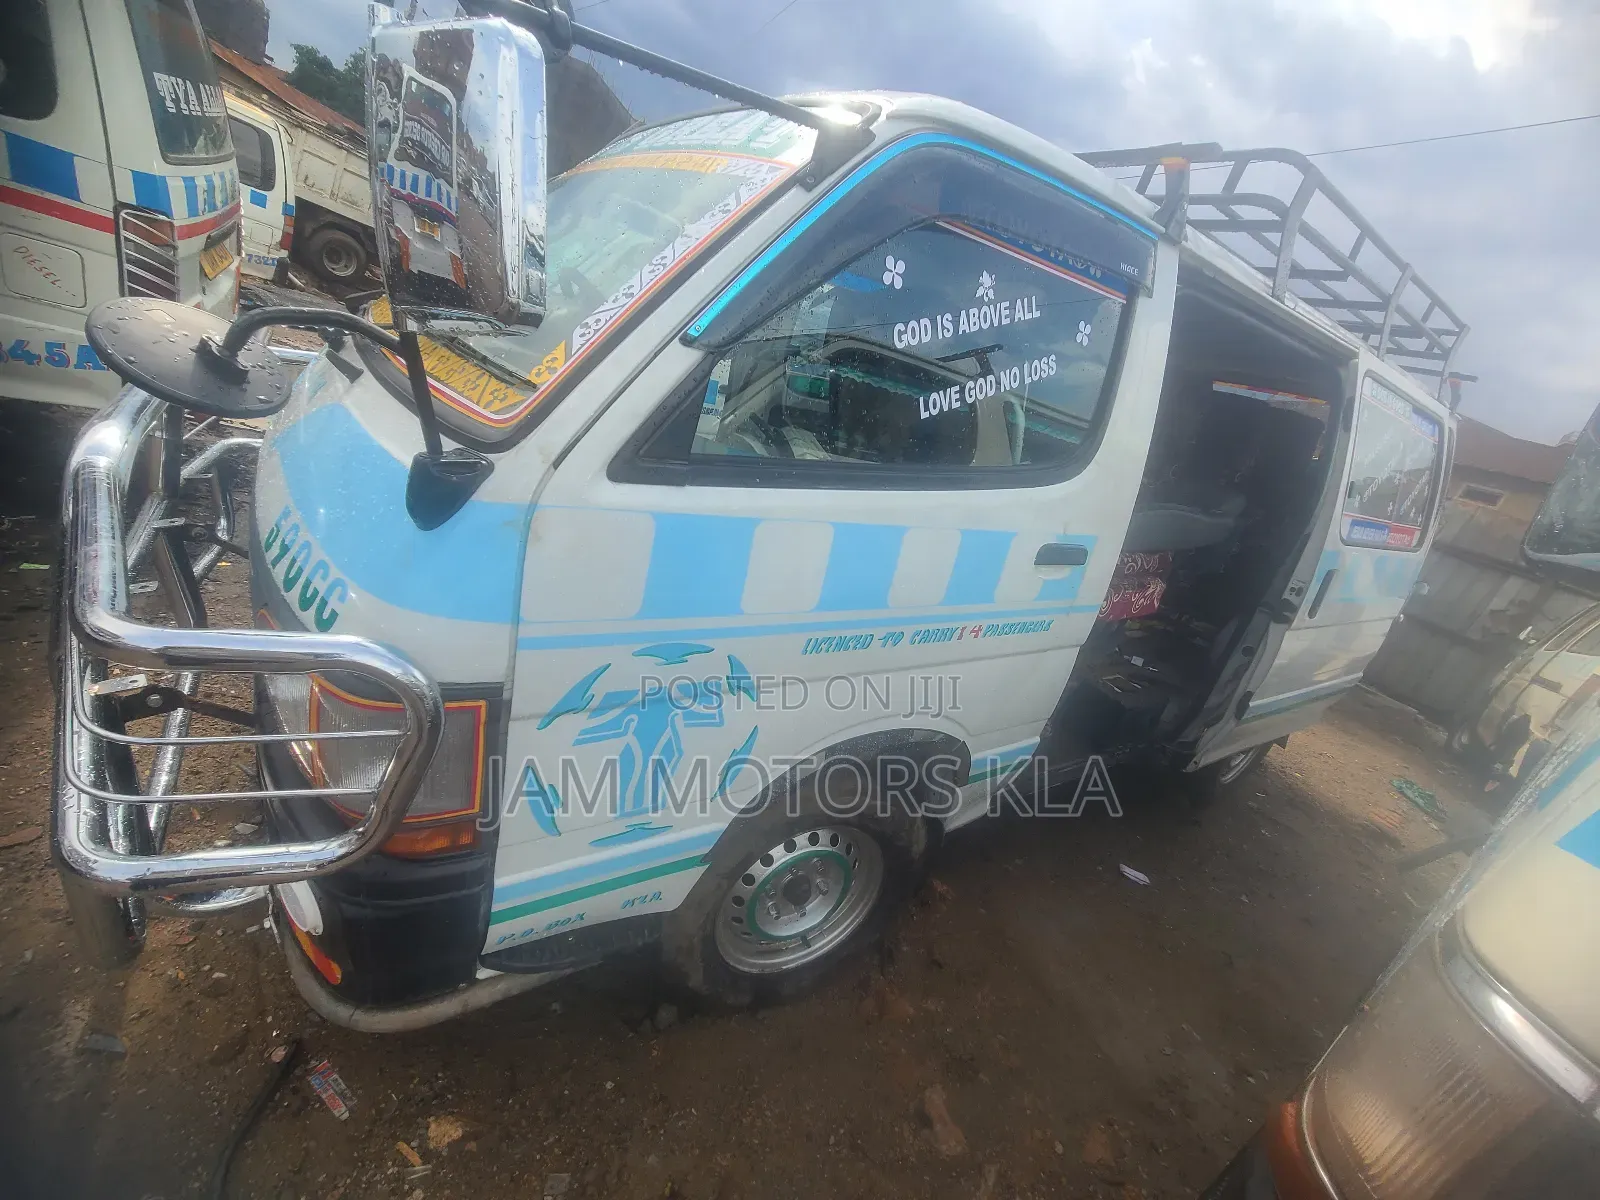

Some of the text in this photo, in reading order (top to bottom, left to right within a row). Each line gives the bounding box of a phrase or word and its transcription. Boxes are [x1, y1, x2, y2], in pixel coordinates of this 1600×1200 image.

[12, 246, 62, 288] DIESEL
[1120, 262, 1139, 276] HIACE
[893, 295, 1041, 349] GOD IS ABOVE ALL
[0, 339, 111, 371] 45A
[919, 354, 1057, 420] LOVE GOD NO LOSS
[264, 504, 349, 633] 590CC
[878, 631, 905, 648] TO
[908, 626, 960, 646] CARRY
[981, 619, 1055, 638] PASSENGERS
[543, 911, 587, 932] BOX
